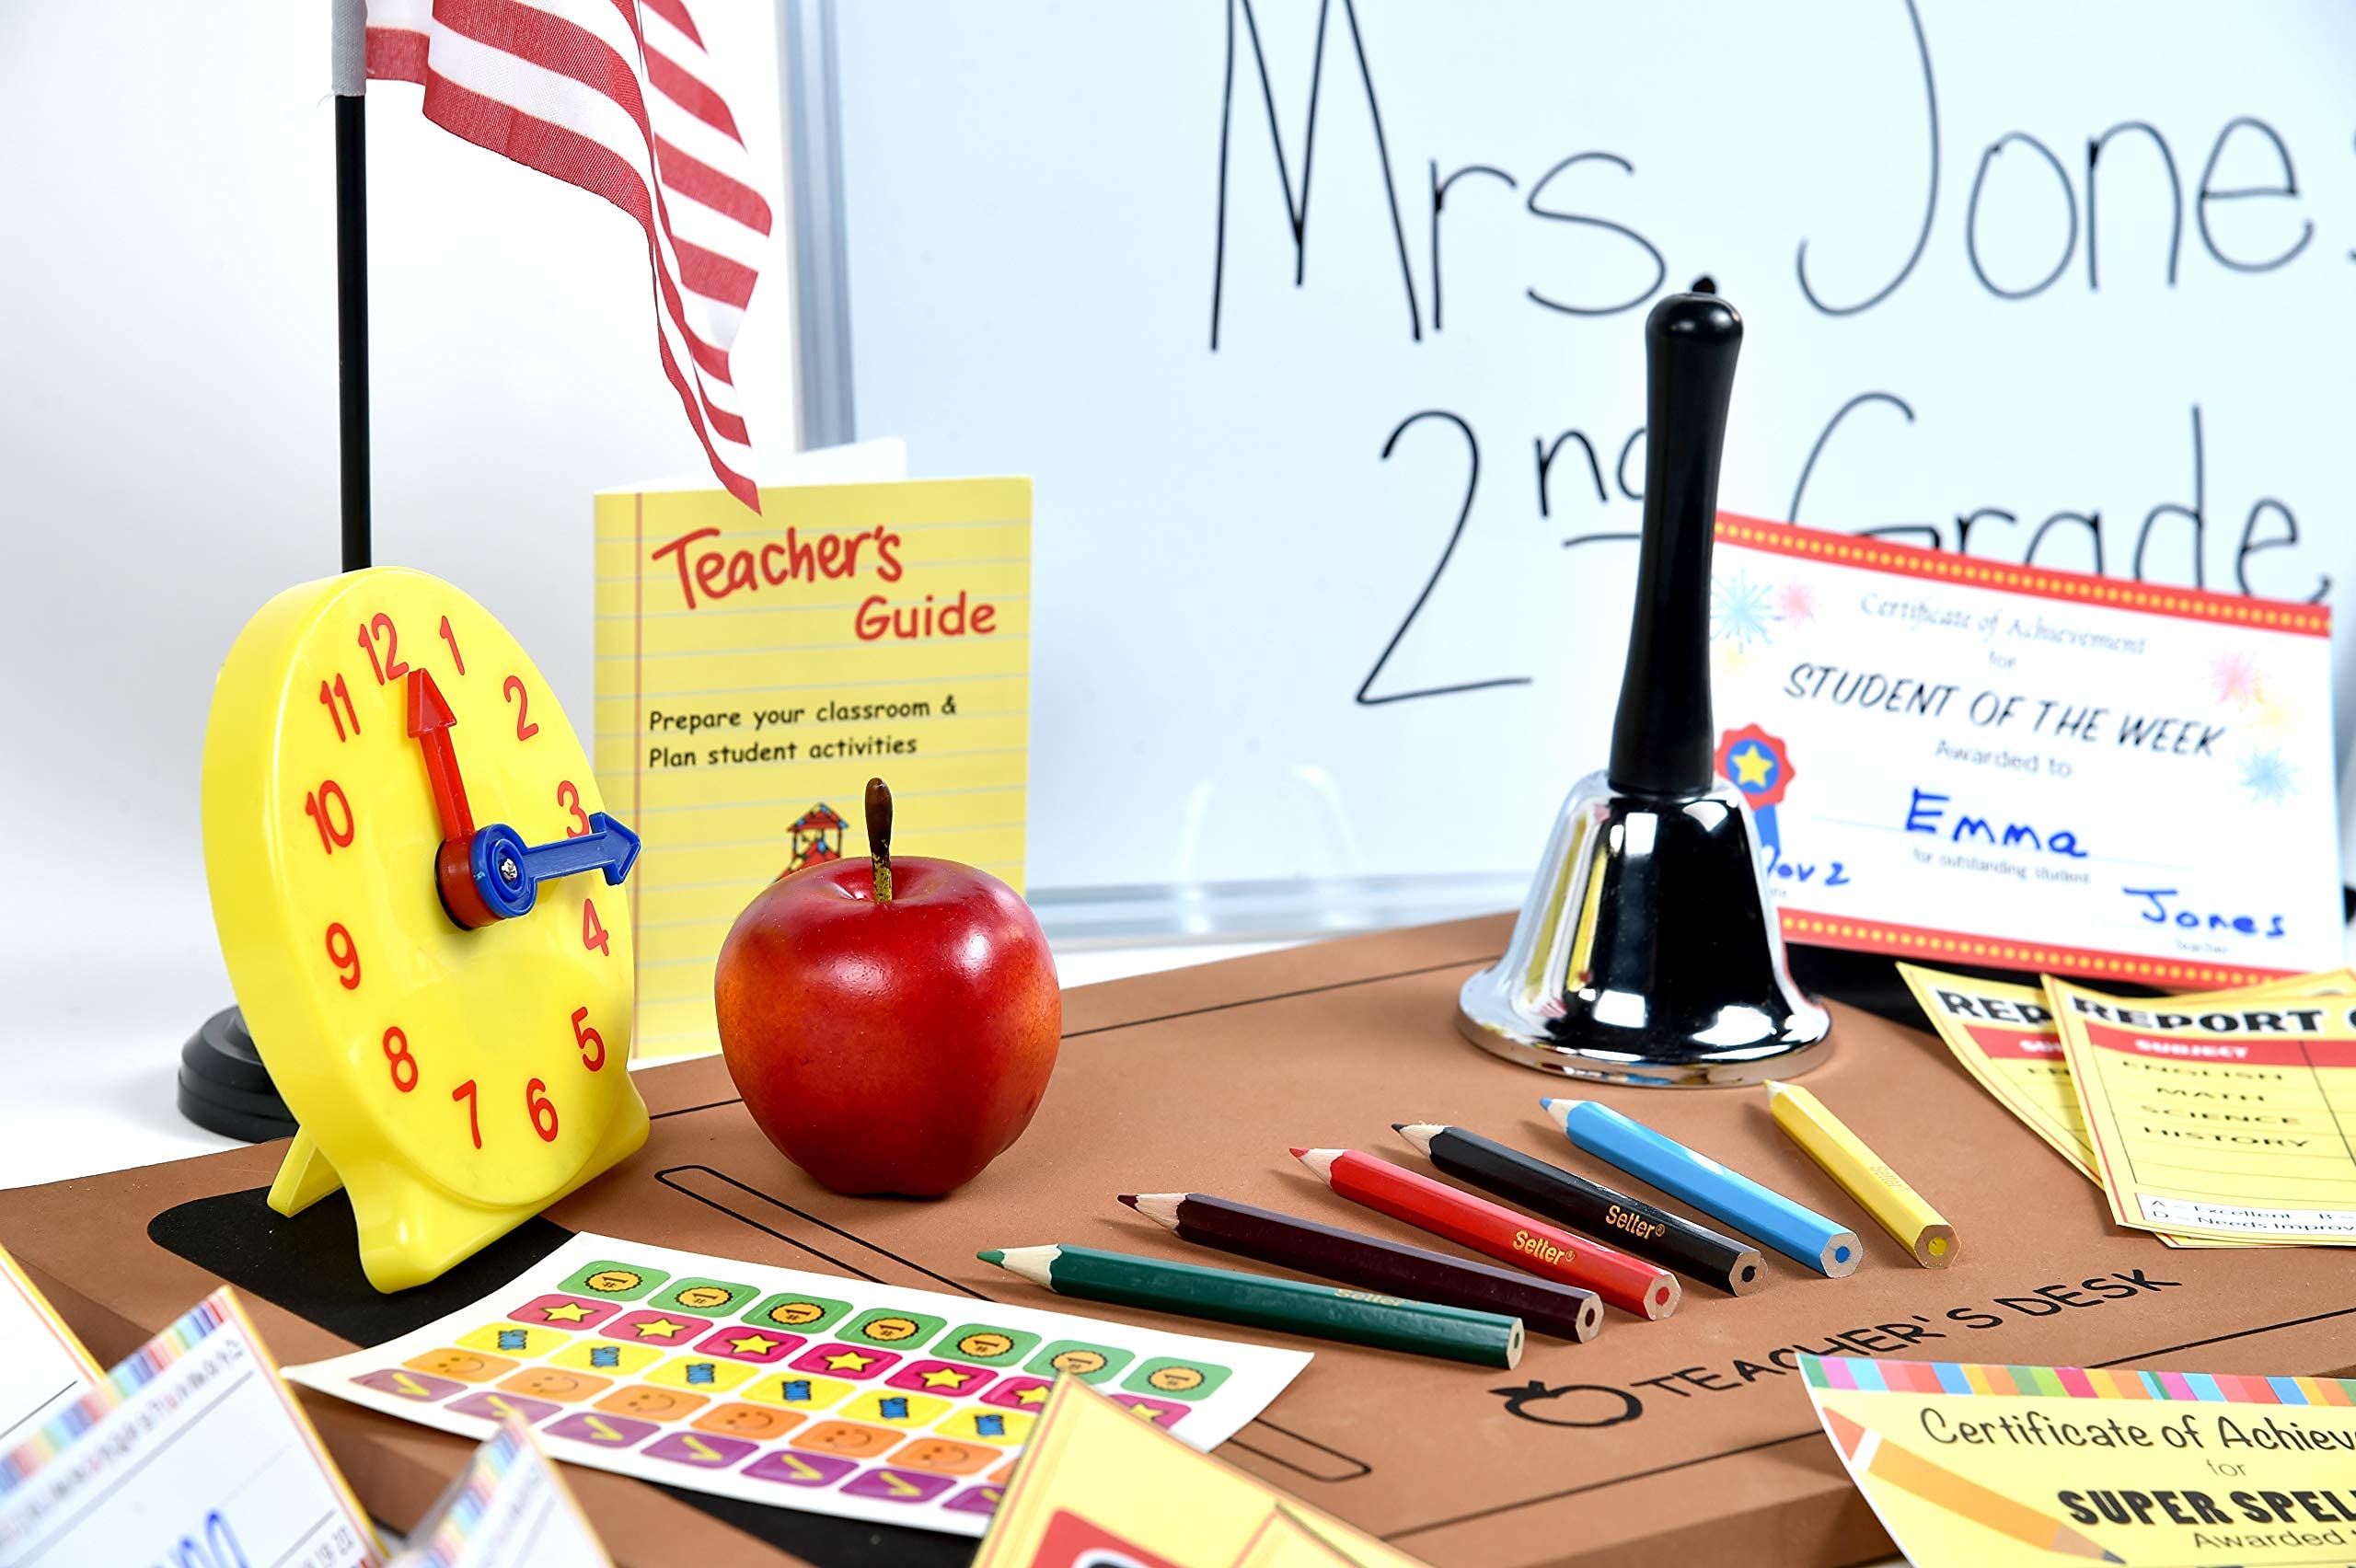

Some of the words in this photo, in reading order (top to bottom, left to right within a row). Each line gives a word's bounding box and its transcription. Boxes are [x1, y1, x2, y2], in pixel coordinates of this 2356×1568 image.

[1796, 0, 2356, 317] Jone
[652, 525, 903, 609] Teacher's
[854, 591, 996, 641] Guide
[1859, 592, 1971, 631] Certificate
[1978, 608, 2001, 642] of
[2006, 615, 2147, 654] Achievement
[357, 613, 409, 686] 12
[439, 616, 465, 675] 1
[318, 673, 361, 743] 11
[503, 675, 538, 742] 2
[649, 709, 742, 734] Prepare
[754, 708, 805, 729] your
[816, 699, 930, 723] classroom
[941, 695, 957, 716] &
[1784, 662, 1961, 718] STUDENT
[1969, 690, 2026, 727] OF
[2032, 700, 2109, 743] THE
[2118, 713, 2227, 757] WEEK
[649, 747, 696, 768] Plan
[708, 740, 798, 766] student
[809, 734, 918, 758] activities
[1935, 739, 2040, 774] Awarded
[2049, 756, 2073, 778] to
[305, 779, 354, 855] 10
[557, 779, 589, 837] 3
[1904, 786, 2088, 859] Emma
[1823, 860, 1851, 887] 2
[583, 898, 609, 957] 4
[2121, 886, 2285, 940] Jones
[325, 922, 362, 991] 9
[571, 1006, 606, 1073] 5
[2072, 995, 2323, 1032] REPORT
[382, 1025, 420, 1094] 8
[2122, 1059, 2283, 1081] ENGLISH
[452, 1079, 483, 1149] 7
[525, 1078, 560, 1143] 6
[2141, 1104, 2301, 1125] SCIENCE
[2155, 1086, 2266, 1101] MATH
[2143, 1125, 2309, 1147] HISTORY
[2194, 1205, 2293, 1220] Excellent
[2198, 1216, 2268, 1229] Needs
[1629, 1308, 2004, 1397] TEACHER'S
[1992, 1268, 2182, 1318] DESK
[1920, 1407, 2154, 1447] Certificate
[2162, 1414, 2203, 1449] of
[2218, 1414, 2356, 1451] Achiev
[2208, 1458, 2247, 1478] for
[2057, 1489, 2234, 1526] SUPER
[2230, 1489, 2356, 1524] SPEL
[2193, 1528, 2347, 1550] Awarded
